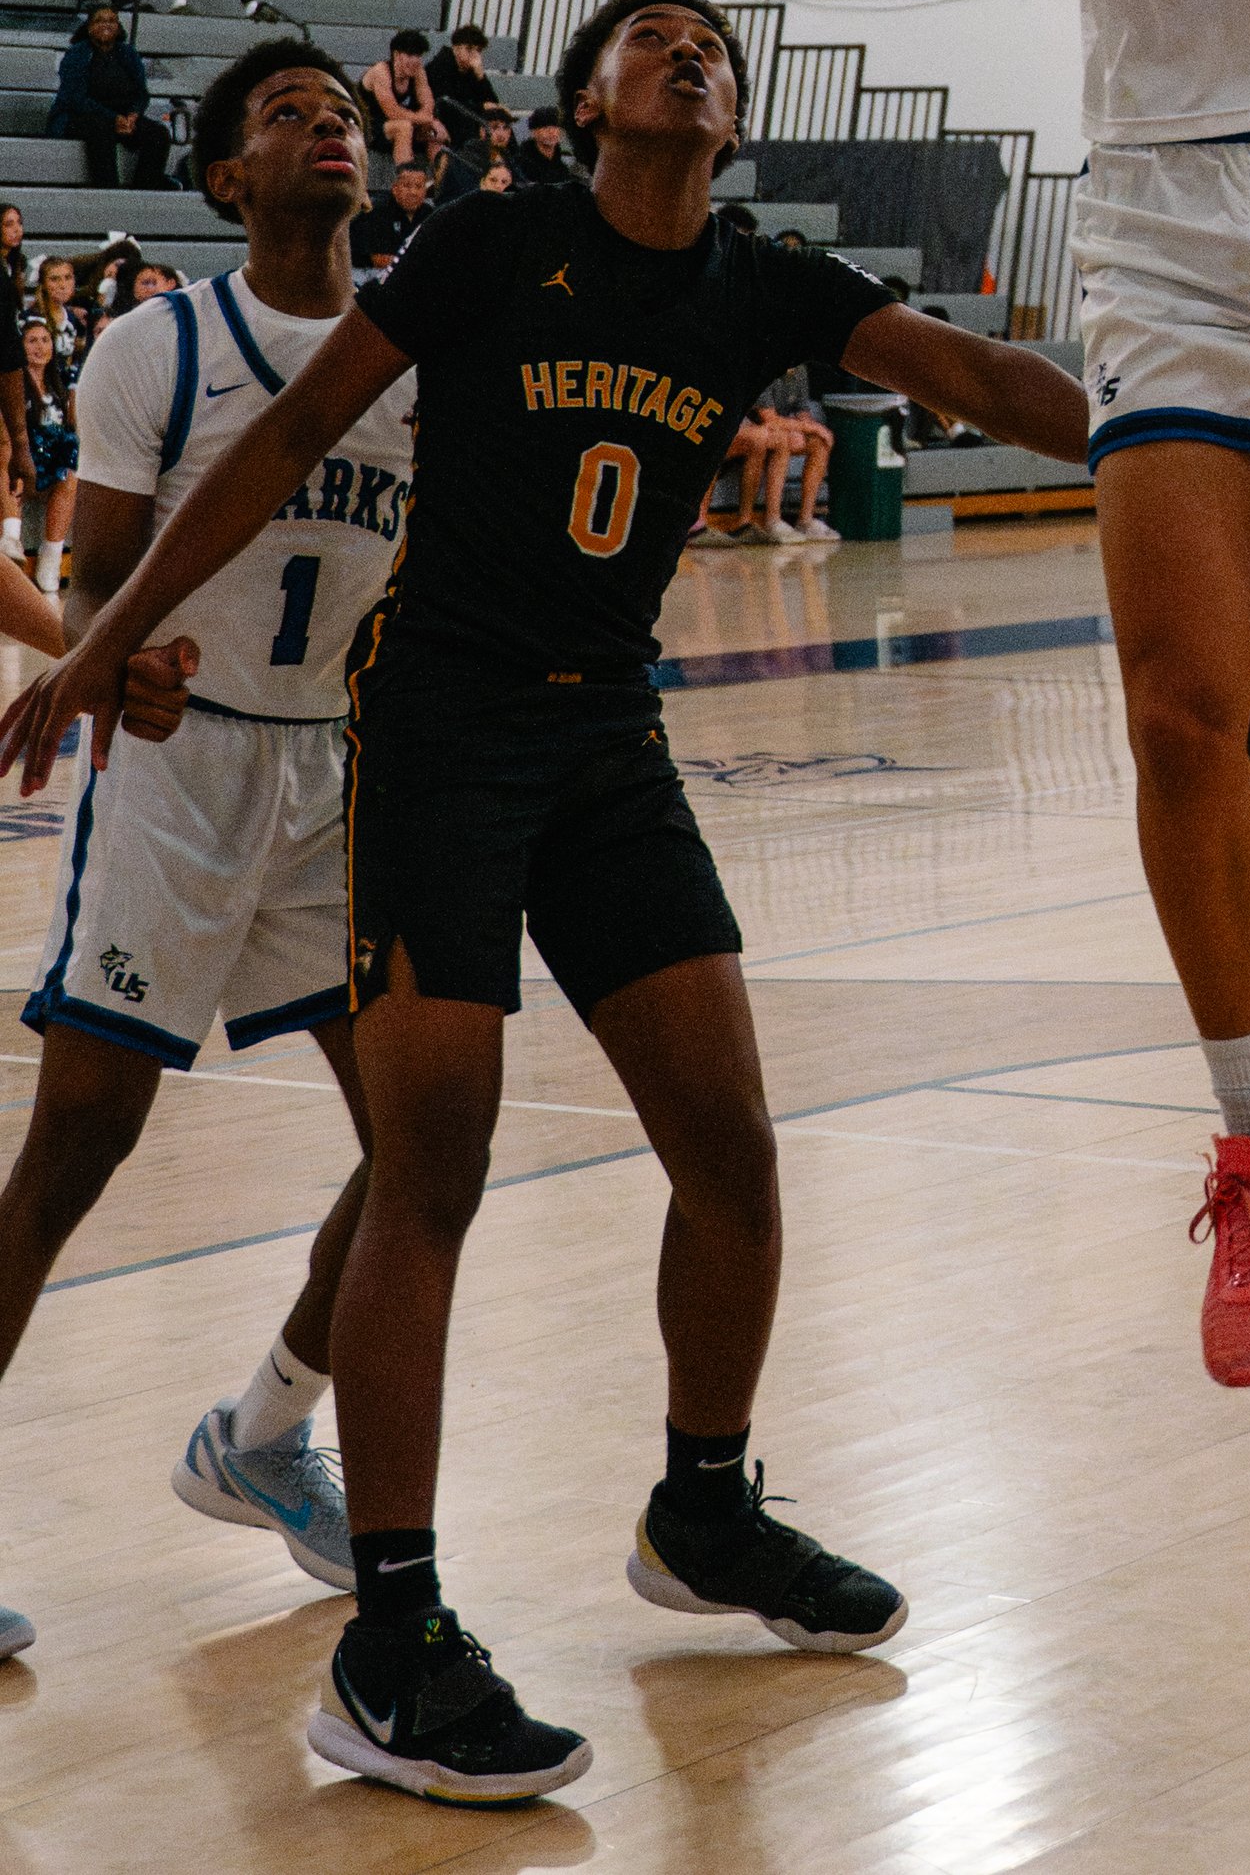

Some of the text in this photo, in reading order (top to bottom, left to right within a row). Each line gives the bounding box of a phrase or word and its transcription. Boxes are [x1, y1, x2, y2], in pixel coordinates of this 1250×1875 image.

[521, 361, 724, 445] HERITAGE
[567, 441, 641, 559] 0
[269, 554, 321, 666] 1
